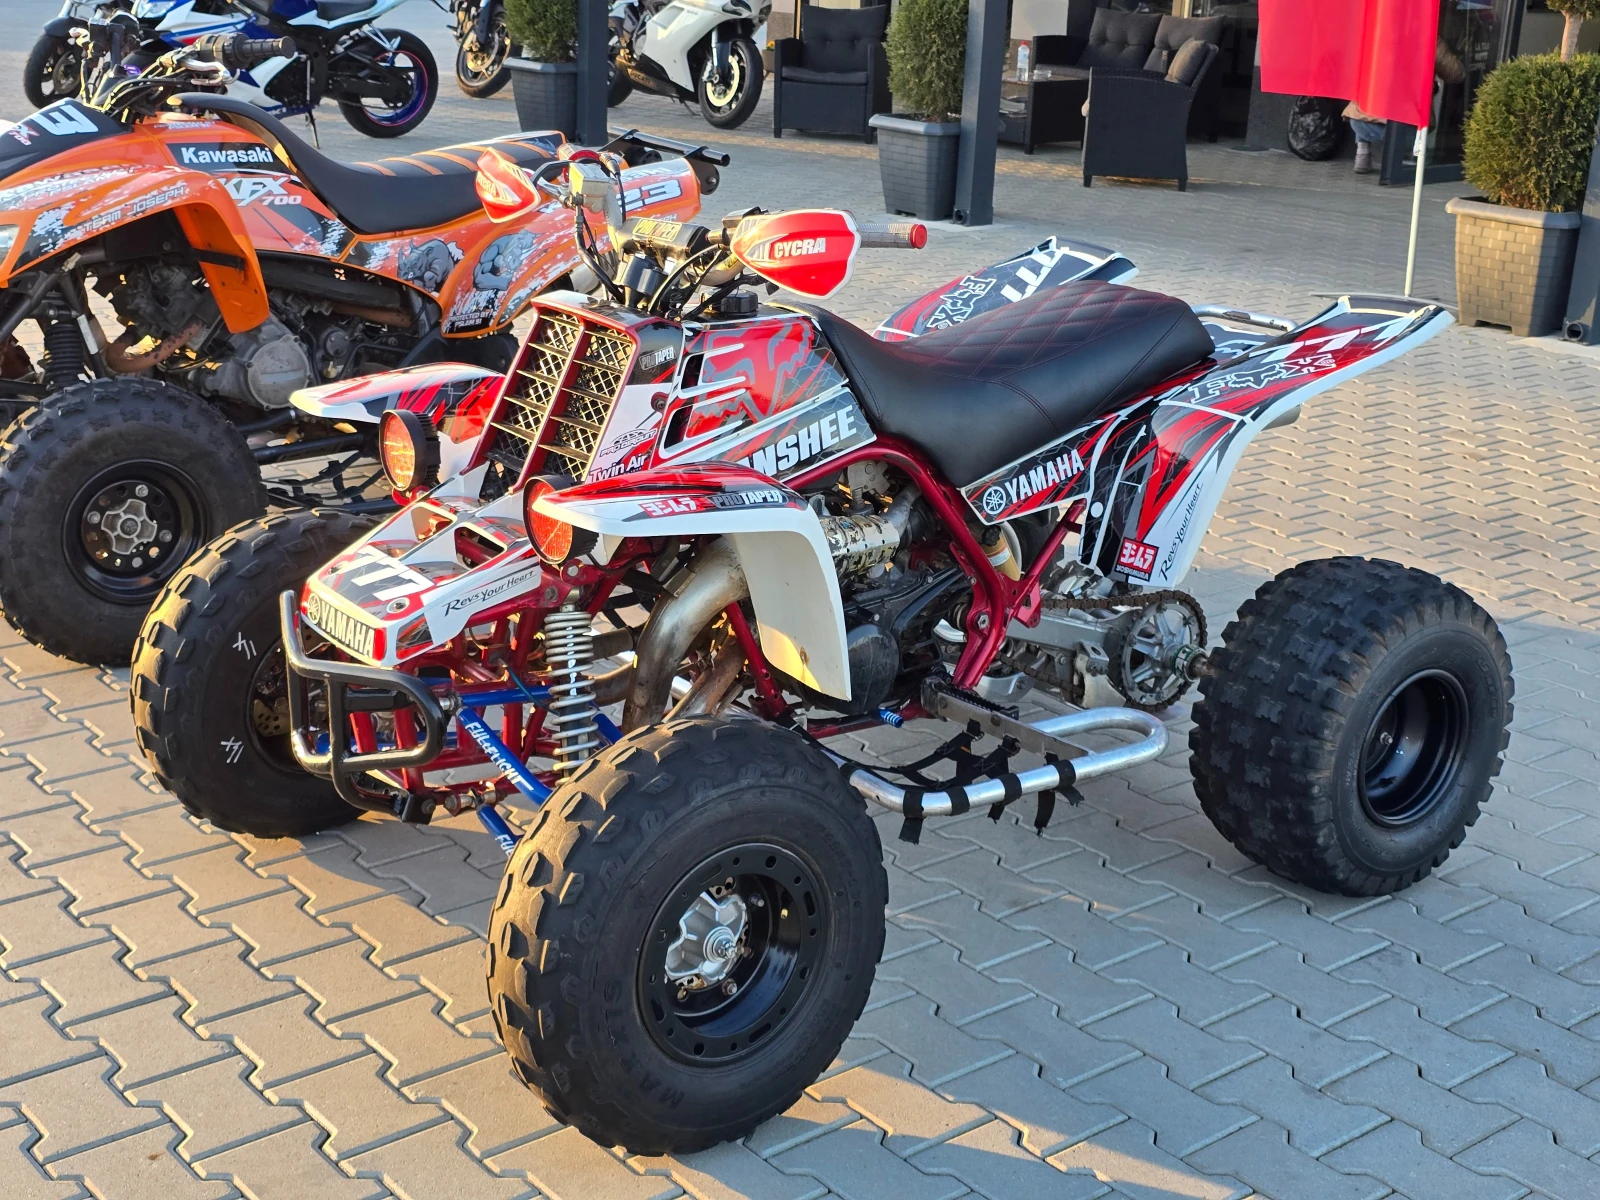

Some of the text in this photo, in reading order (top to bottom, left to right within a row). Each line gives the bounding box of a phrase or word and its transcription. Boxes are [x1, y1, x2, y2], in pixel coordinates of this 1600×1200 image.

[181, 147, 273, 163] Kawasaki
[83, 209, 121, 233] TEAM
[128, 186, 185, 215] JOSEPH
[261, 195, 302, 205] 700
[615, 179, 682, 213] 23
[774, 238, 826, 258] CYCRA
[600, 429, 657, 458] PRO CIRCUIT
[589, 461, 626, 483] Twin
[626, 453, 648, 472] Air
[1004, 448, 1085, 504] YAMAHA
[1158, 482, 1203, 582] Revs Your Heart
[1116, 564, 1149, 581] YOSHIMURA
[442, 569, 535, 617] Revs Your Heart
[320, 600, 375, 658] YAMAHA
